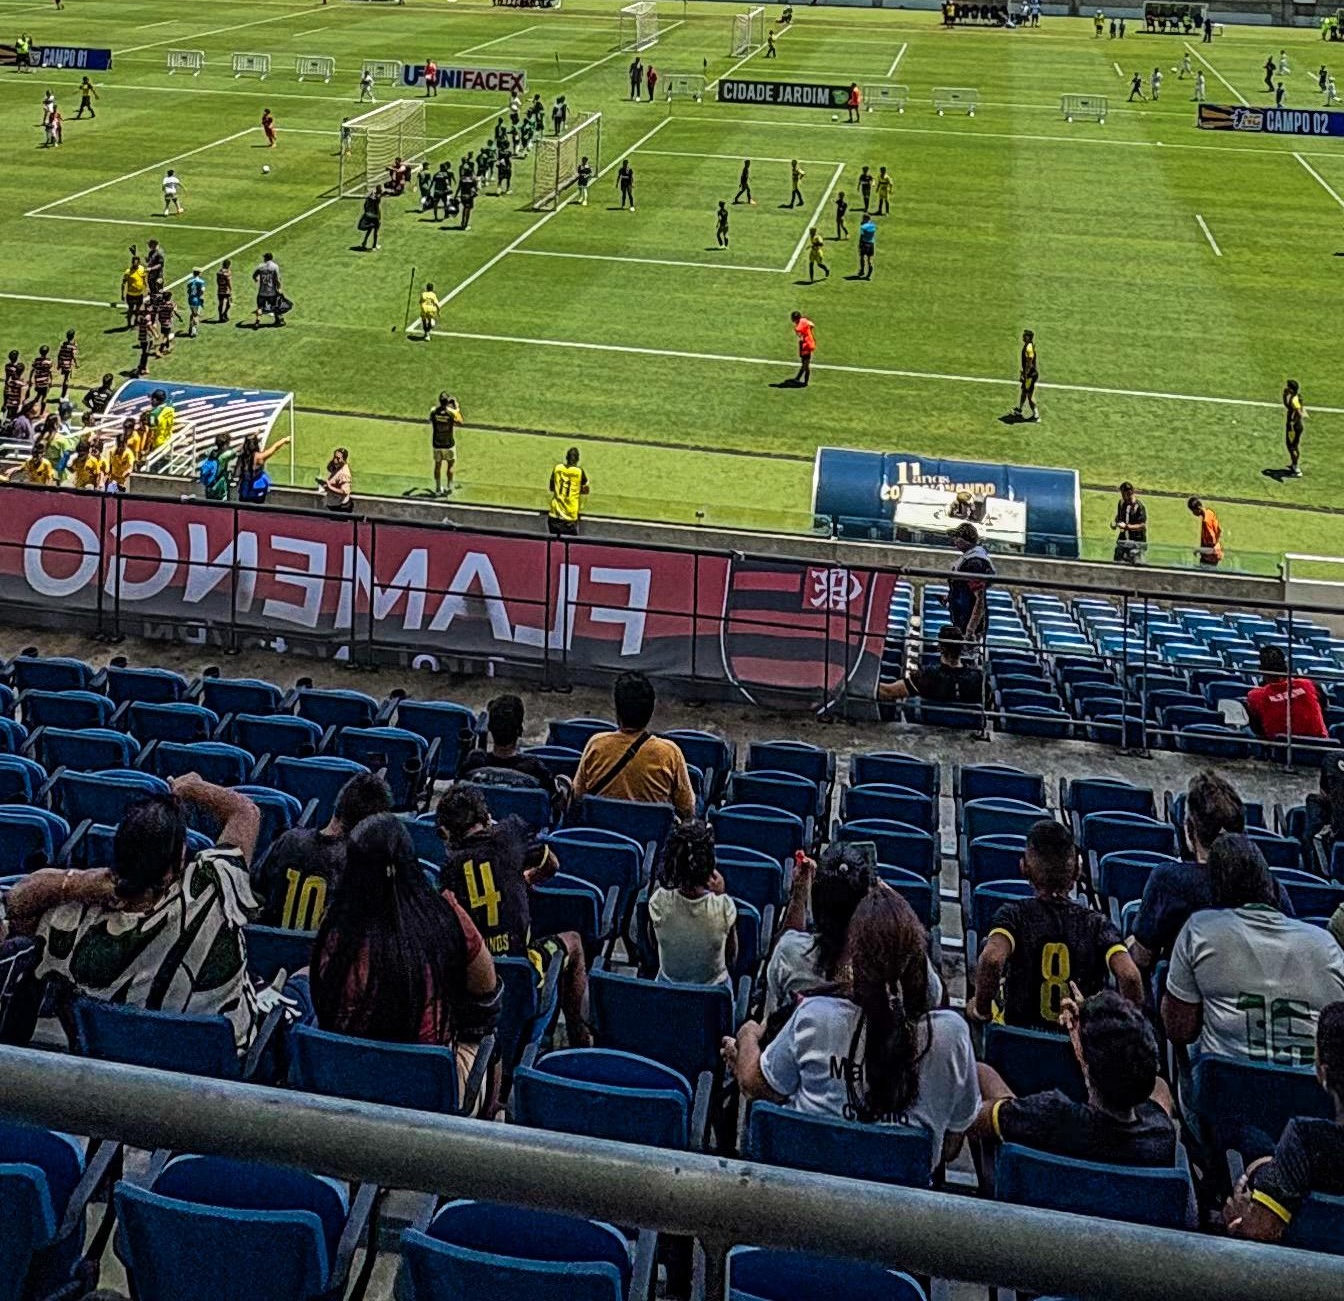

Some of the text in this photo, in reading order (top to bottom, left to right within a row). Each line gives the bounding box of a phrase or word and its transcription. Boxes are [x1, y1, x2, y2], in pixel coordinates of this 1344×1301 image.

[43, 48, 76, 67] CAMPO
[723, 82, 830, 106] CIDADE JARDIM
[1266, 111, 1310, 133] CAMPO
[1313, 112, 1329, 134] 02
[896, 461, 921, 484] 11
[912, 473, 951, 484] anos
[282, 867, 328, 931] 10
[463, 859, 502, 927] 4
[1040, 942, 1071, 1022] 8
